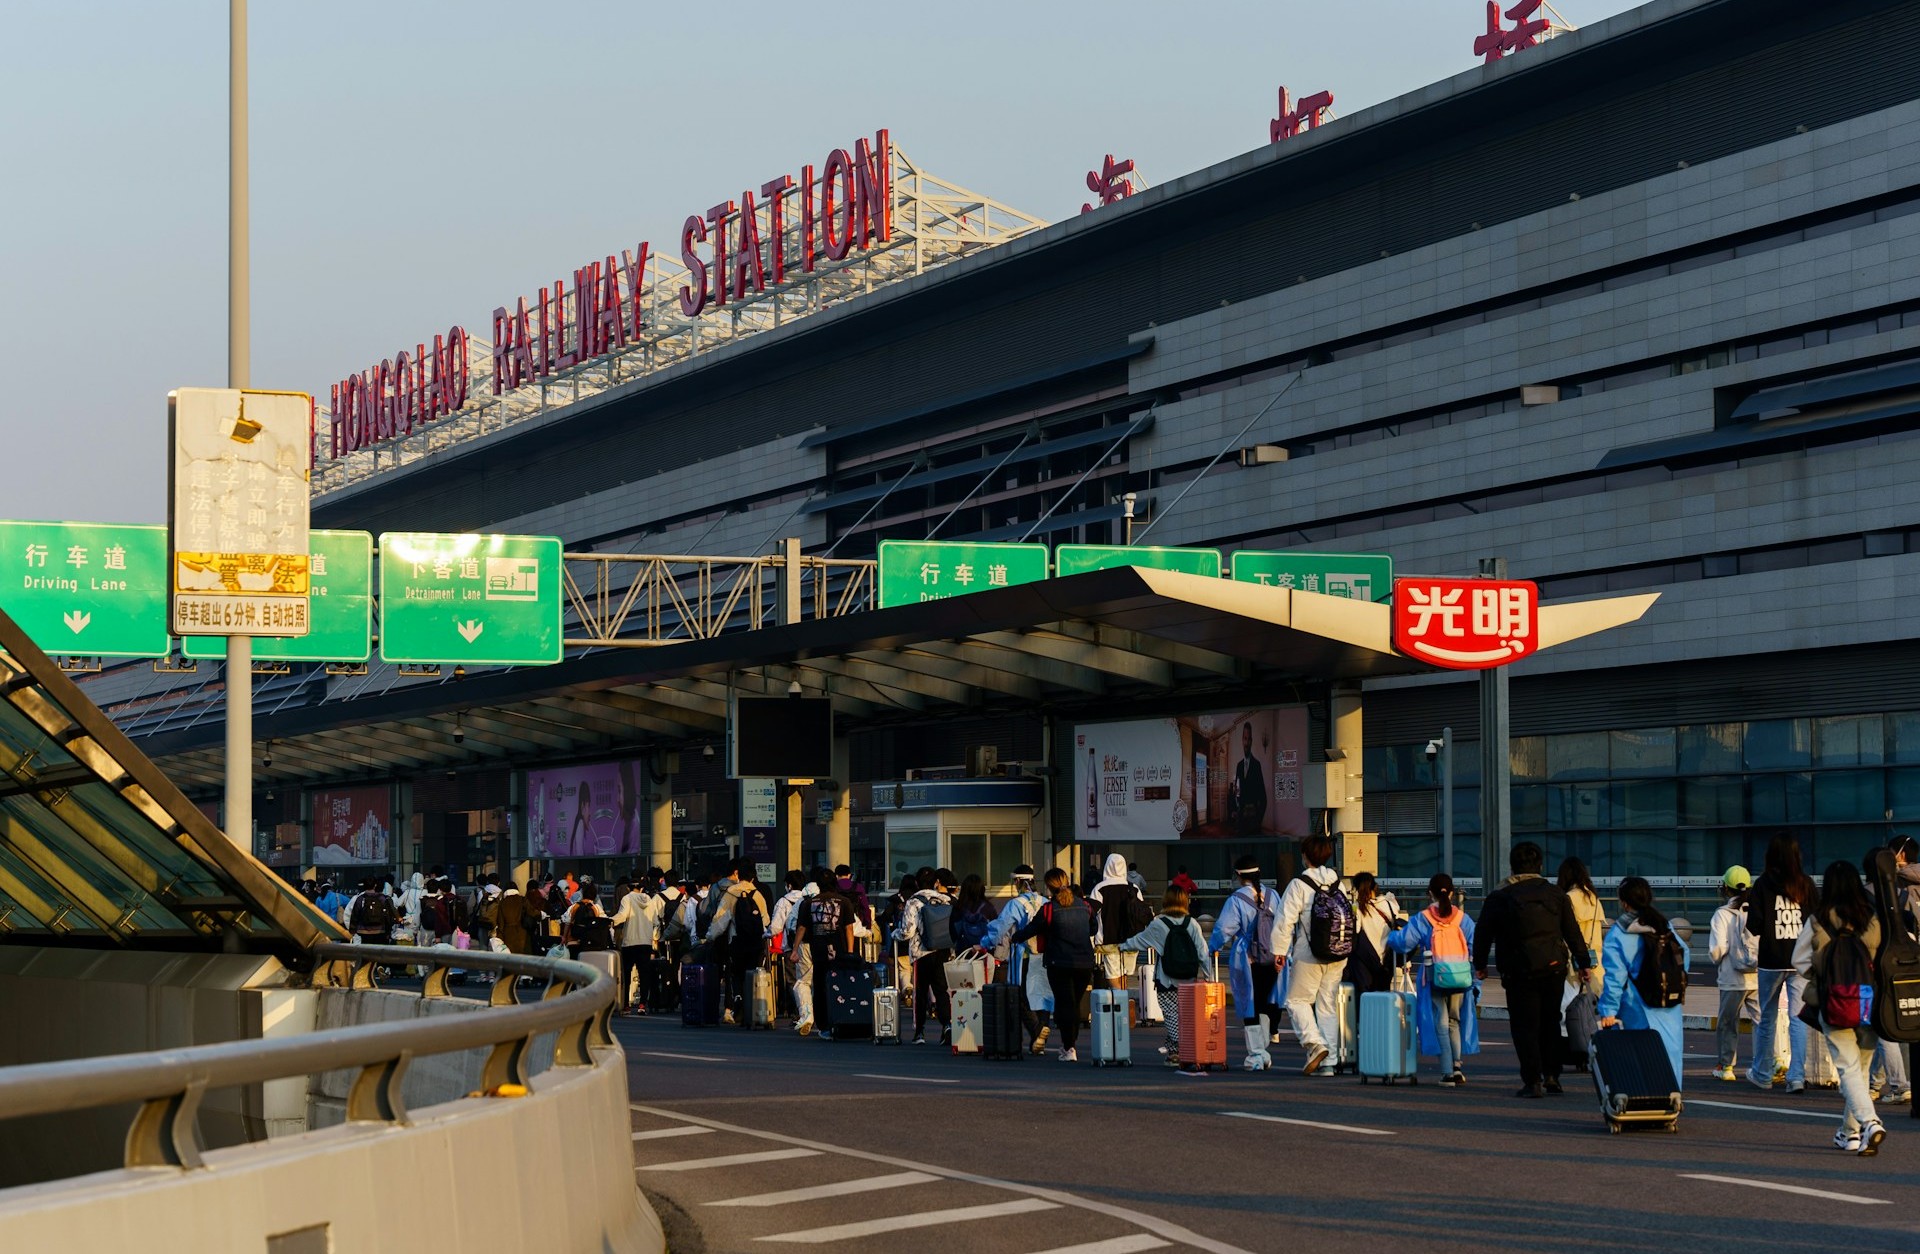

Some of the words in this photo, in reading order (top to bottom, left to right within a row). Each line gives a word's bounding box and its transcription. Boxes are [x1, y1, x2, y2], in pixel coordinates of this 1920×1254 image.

[331, 326, 467, 459] HONGQIAO
[493, 241, 648, 395] RAILWAY
[679, 129, 890, 317] STATION
[25, 544, 127, 570] 行车道
[920, 562, 1009, 586] 行车道
[24, 575, 78, 593] Driving
[91, 577, 127, 591] Lane
[405, 587, 455, 601] Detrainment
[463, 588, 482, 601] Lane
[178, 601, 305, 628] 停车超出6分钟、自动拍照
[1407, 586, 1530, 638] 光明
[1103, 777, 1128, 794] JERSEY
[1105, 793, 1126, 806] CATTLE
[1775, 910, 1803, 925] JOR
[1775, 925, 1803, 940] DAN
